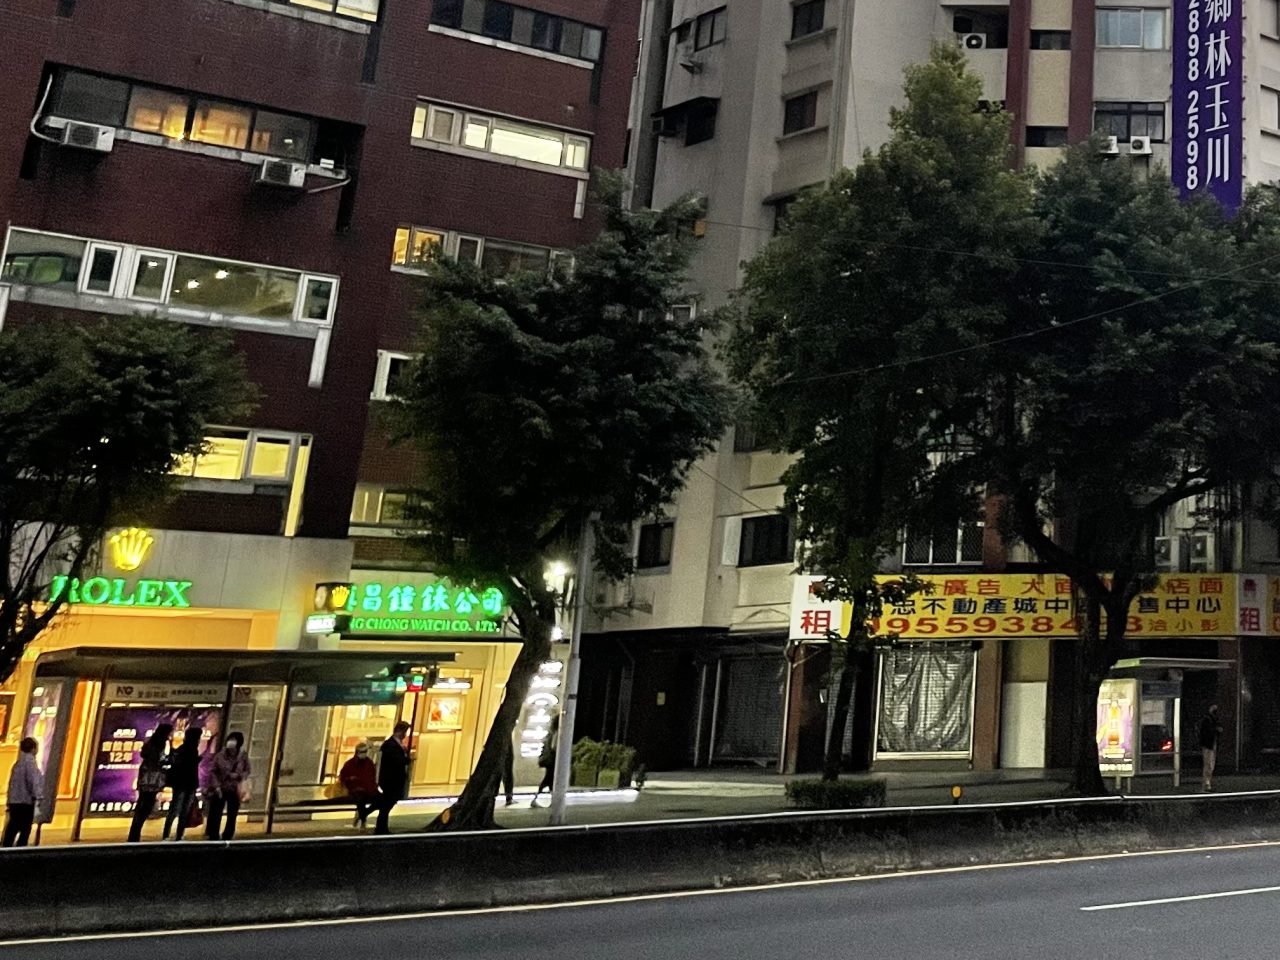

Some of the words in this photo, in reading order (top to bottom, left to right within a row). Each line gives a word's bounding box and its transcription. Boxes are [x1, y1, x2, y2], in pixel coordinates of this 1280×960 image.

[1186, 90, 1199, 190] 2598
[50, 575, 193, 607] ROLEX
[800, 610, 831, 635] 租
[864, 615, 1143, 634] 95593843
[1239, 607, 1261, 632] 租
